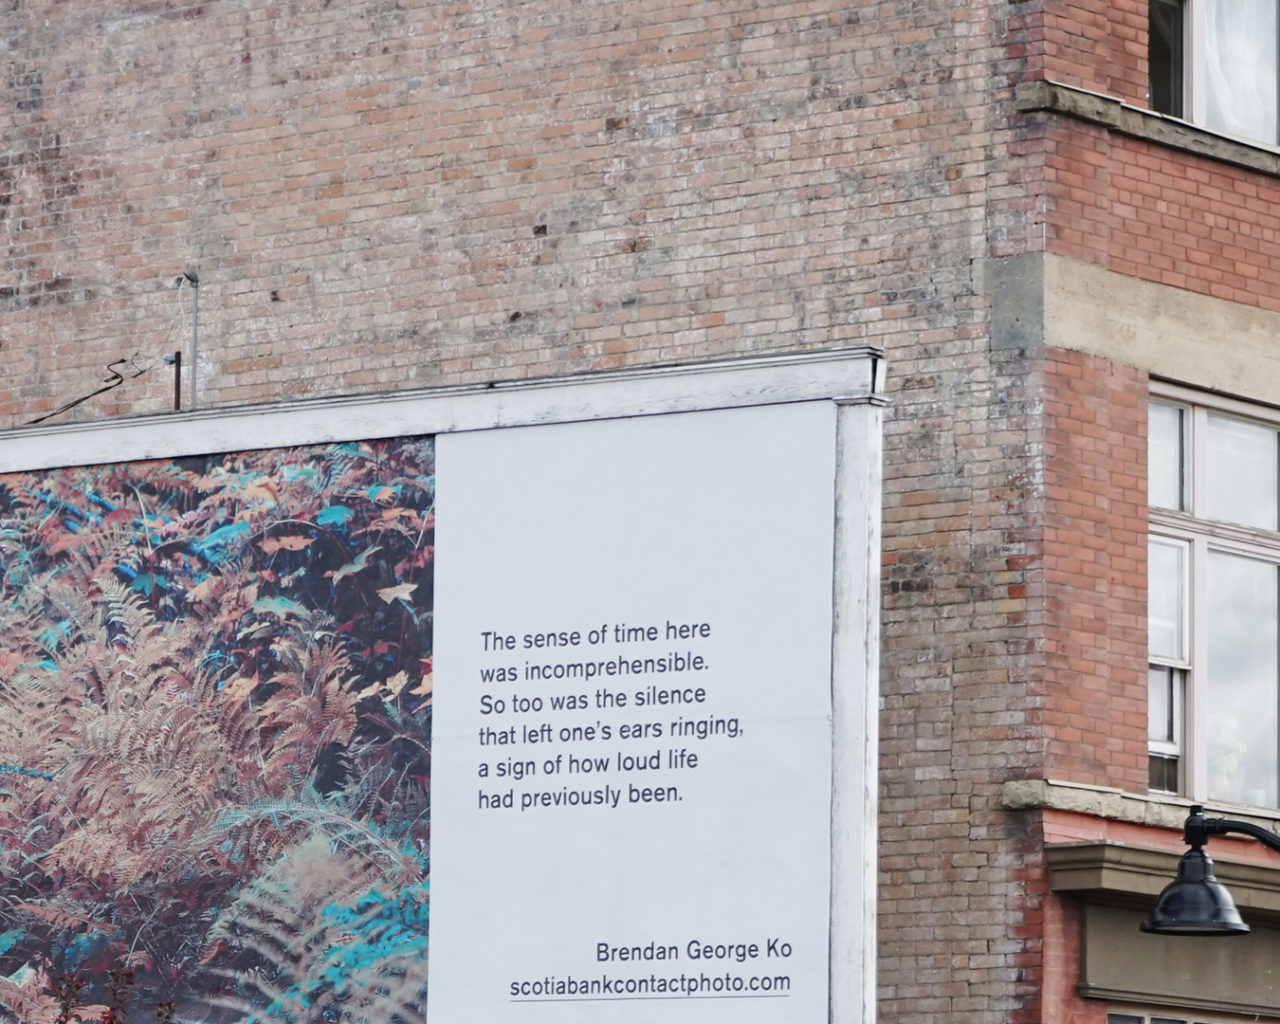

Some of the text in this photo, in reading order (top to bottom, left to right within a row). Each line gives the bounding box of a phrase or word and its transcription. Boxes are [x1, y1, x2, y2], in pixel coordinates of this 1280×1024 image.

[481, 621, 711, 651] The sense of time here
[481, 653, 709, 683] was incomprehensible.
[480, 686, 706, 715] So too was the silence
[479, 726, 516, 745] that
[523, 724, 553, 744] left
[619, 720, 663, 739] ears
[670, 716, 744, 740] ringing,
[478, 749, 698, 780] a sign of how loud life
[478, 784, 683, 812] had previously been.
[596, 938, 793, 963] Brendan George Ko
[510, 973, 791, 997] scotiabankcontactphoto.com
